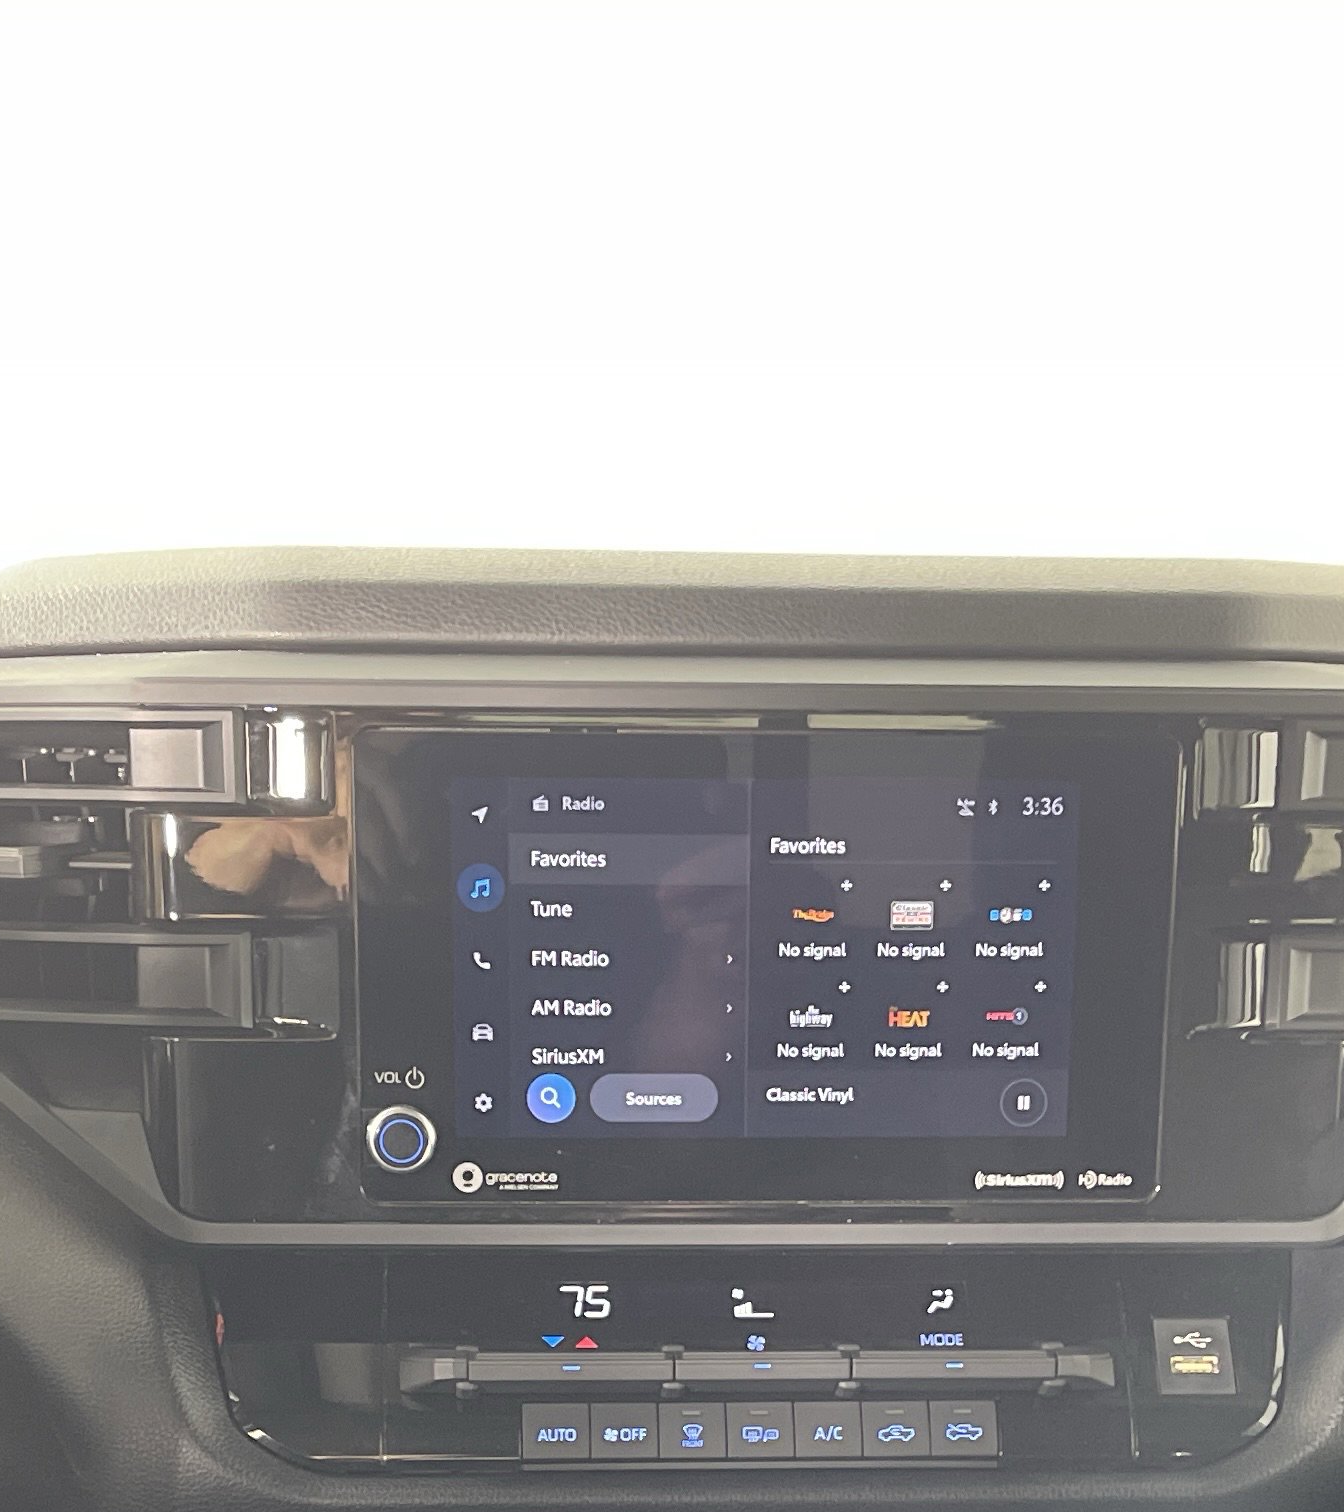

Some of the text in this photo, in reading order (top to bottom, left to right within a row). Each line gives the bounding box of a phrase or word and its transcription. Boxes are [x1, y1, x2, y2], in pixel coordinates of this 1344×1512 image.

[561, 796, 605, 812] Radio
[1022, 796, 1064, 816] 3:36
[769, 836, 846, 855] Favorites
[530, 850, 607, 868] Favorites
[530, 900, 573, 918] Tune
[530, 949, 610, 968] FM Radio
[778, 942, 847, 961] No signal
[876, 942, 945, 961] No signal
[974, 942, 1044, 961] No signal
[530, 999, 613, 1017] AM Radio
[788, 1009, 834, 1028] highway
[888, 1010, 931, 1028] HEAT
[531, 1047, 605, 1065] SiriusXM
[776, 1042, 844, 1061] No signal
[874, 1042, 942, 1061] No signal
[971, 1041, 1040, 1060] No signal
[374, 1071, 401, 1085] VOL
[625, 1091, 682, 1106] Sources
[765, 1086, 855, 1105] Classic Vinyl
[485, 1171, 558, 1186] gracenote
[985, 1173, 1054, 1187] SiriusXM
[1098, 1173, 1133, 1187] Radio
[558, 1284, 612, 1319] 75
[919, 1332, 965, 1347] MODE
[536, 1426, 578, 1443] AUTO
[619, 1426, 648, 1443] OFF
[813, 1425, 845, 1442] A/C
